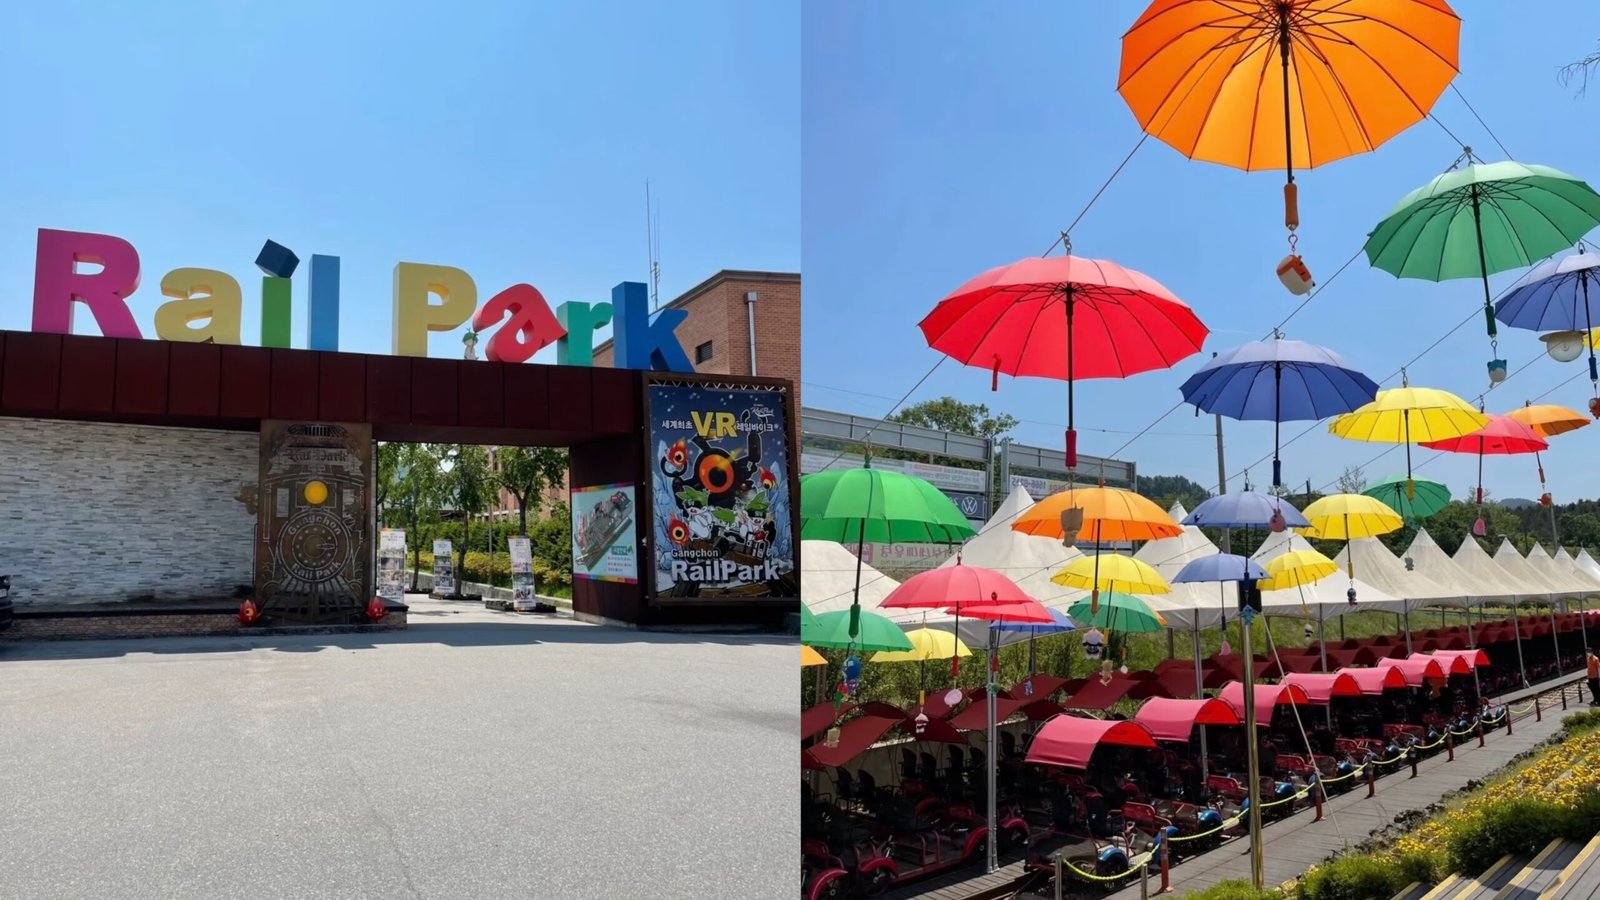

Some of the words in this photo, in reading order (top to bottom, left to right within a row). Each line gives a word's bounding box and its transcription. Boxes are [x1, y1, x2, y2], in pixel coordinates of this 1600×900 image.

[31, 228, 340, 352] Rail
[392, 261, 696, 372] Park
[661, 419, 693, 430] 세계최초
[690, 411, 738, 438] VR
[736, 421, 774, 432] 레일바이크
[670, 548, 719, 559] Gangchon
[316, 562, 341, 579] Park
[671, 560, 780, 581] RailPark
